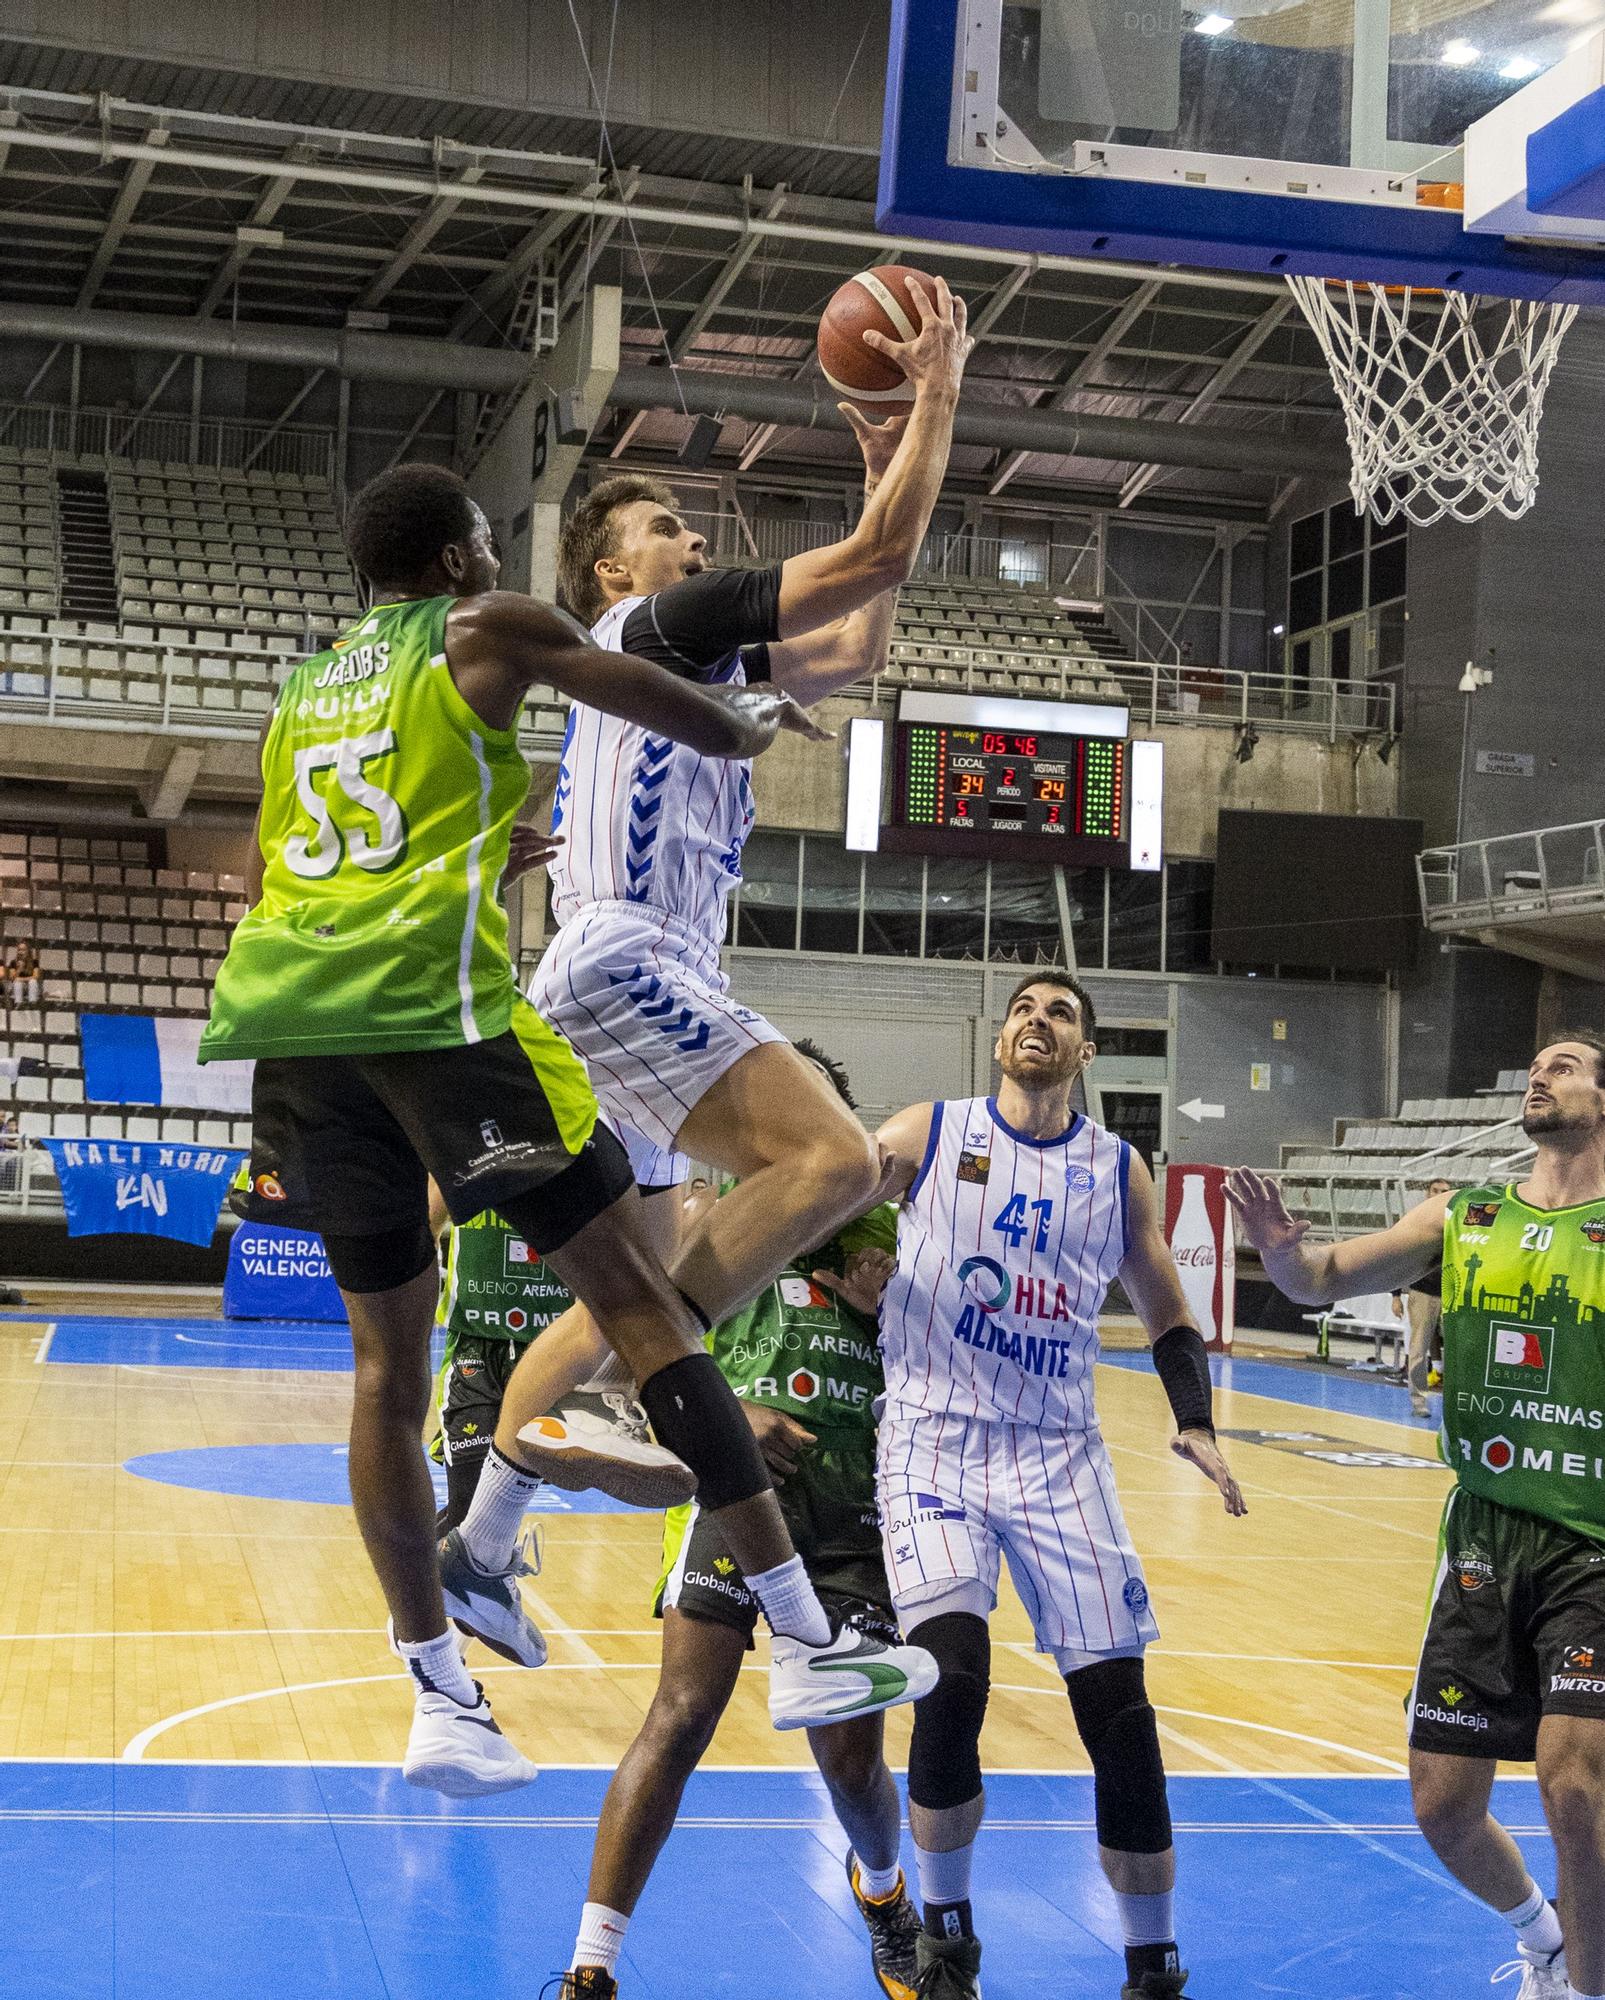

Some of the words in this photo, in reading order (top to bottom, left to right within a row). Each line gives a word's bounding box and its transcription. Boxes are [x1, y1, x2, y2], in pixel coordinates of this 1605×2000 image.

[952, 757, 986, 769] LOCAL
[1033, 762, 1067, 775] VISITANTE
[960, 774, 984, 794] 34
[1003, 769, 1015, 785] 2
[1040, 780, 1065, 799] 24
[284, 728, 409, 880] 55
[957, 800, 967, 816] 5
[949, 818, 974, 828] FALTAS
[1050, 806, 1060, 823] 3
[991, 820, 1023, 831] JUGADOR
[1041, 823, 1066, 834] FALTAS
[63, 1142, 142, 1167] KALI
[993, 1193, 1054, 1253] 41
[1458, 1231, 1490, 1245] vive
[1520, 1223, 1554, 1252] 20
[467, 1279, 518, 1296] BUENO
[522, 1284, 569, 1298] ARENAS
[1014, 1274, 1069, 1322] HLA
[732, 1332, 802, 1364] BUENO
[809, 1333, 882, 1366] ARENAS
[954, 1303, 1070, 1378] ALICANTE
[1510, 1399, 1603, 1430] ARENAS
[684, 1571, 750, 1606] Globalcaja
[1415, 1703, 1489, 1732] Globalcaja
